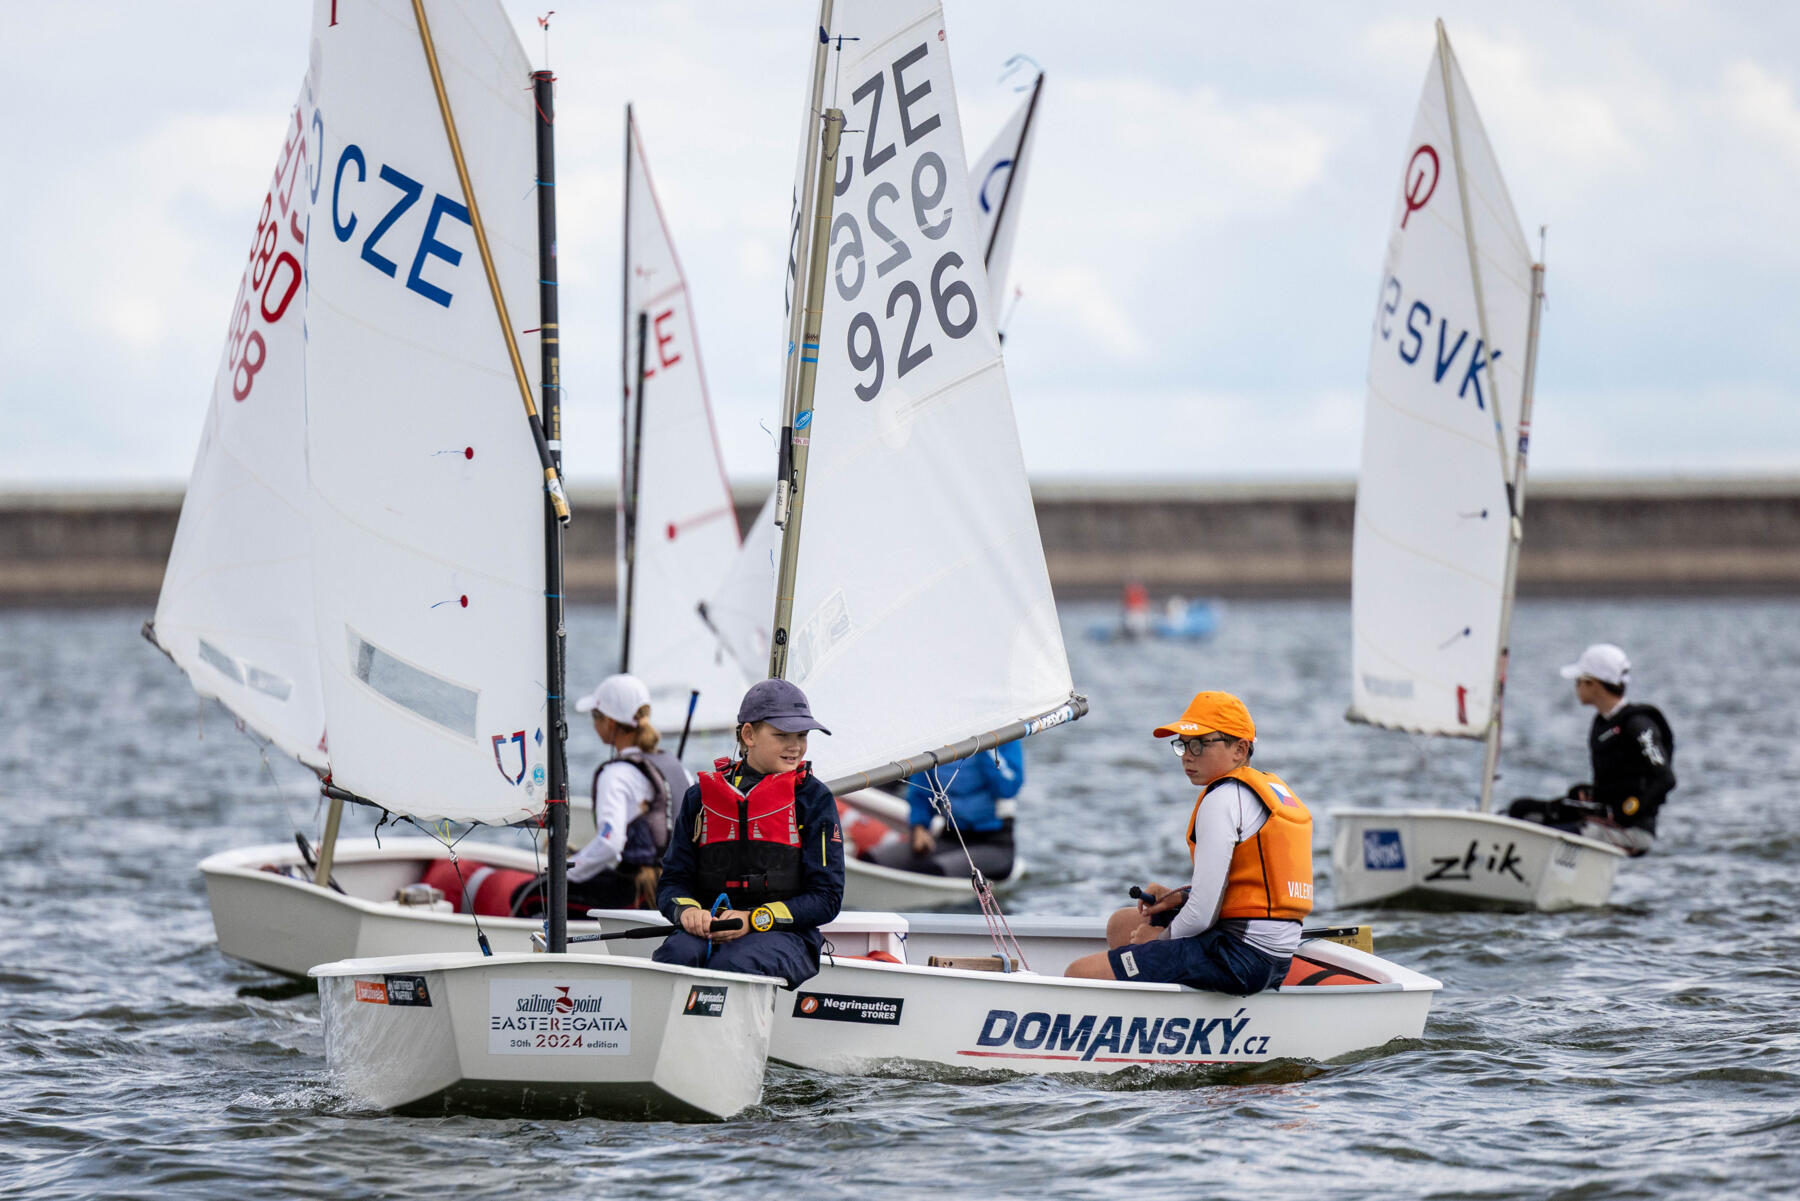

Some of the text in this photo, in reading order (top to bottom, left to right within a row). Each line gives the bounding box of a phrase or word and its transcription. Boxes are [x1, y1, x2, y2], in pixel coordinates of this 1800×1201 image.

[834, 41, 942, 198] ZE
[332, 143, 474, 309] CZE
[847, 251, 978, 402] 926
[1398, 300, 1503, 411] SVK
[515, 993, 602, 1016] sailing point
[823, 998, 898, 1013] Negrinautica
[861, 1010, 896, 1020] STORES
[510, 1034, 619, 1049] 30th 2024 edition
